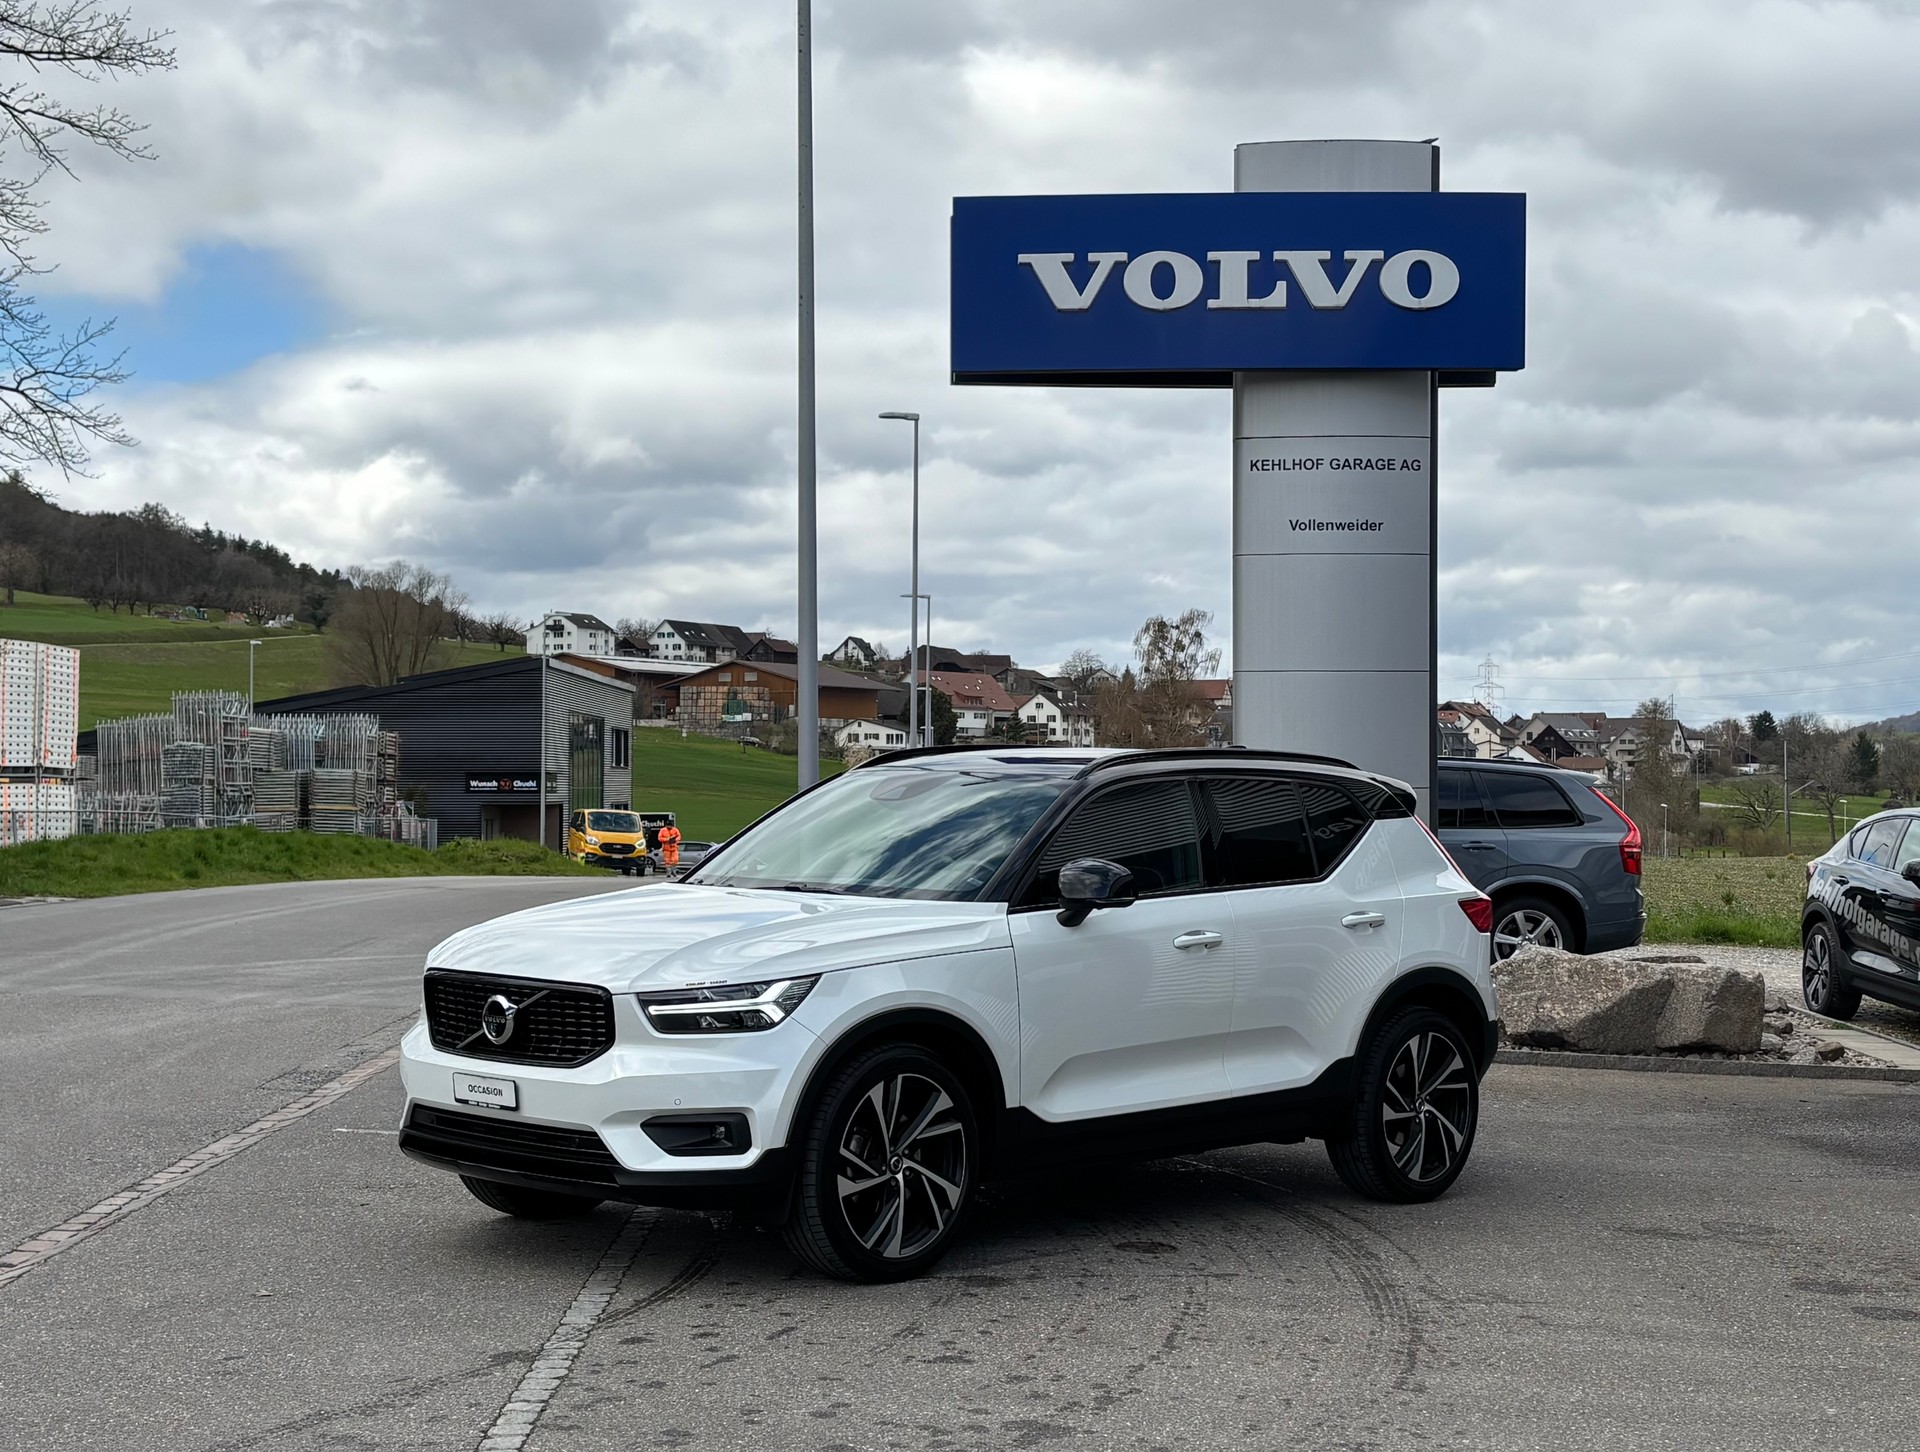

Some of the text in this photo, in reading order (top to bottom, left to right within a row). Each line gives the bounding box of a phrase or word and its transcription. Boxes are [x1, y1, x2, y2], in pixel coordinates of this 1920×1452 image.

[1017, 250, 1460, 310] VOLVO
[1250, 458, 1422, 472] KEHLHOF GARAGE AG
[1289, 519, 1384, 531] Vollenweider
[467, 1084, 503, 1097] OCCASION
